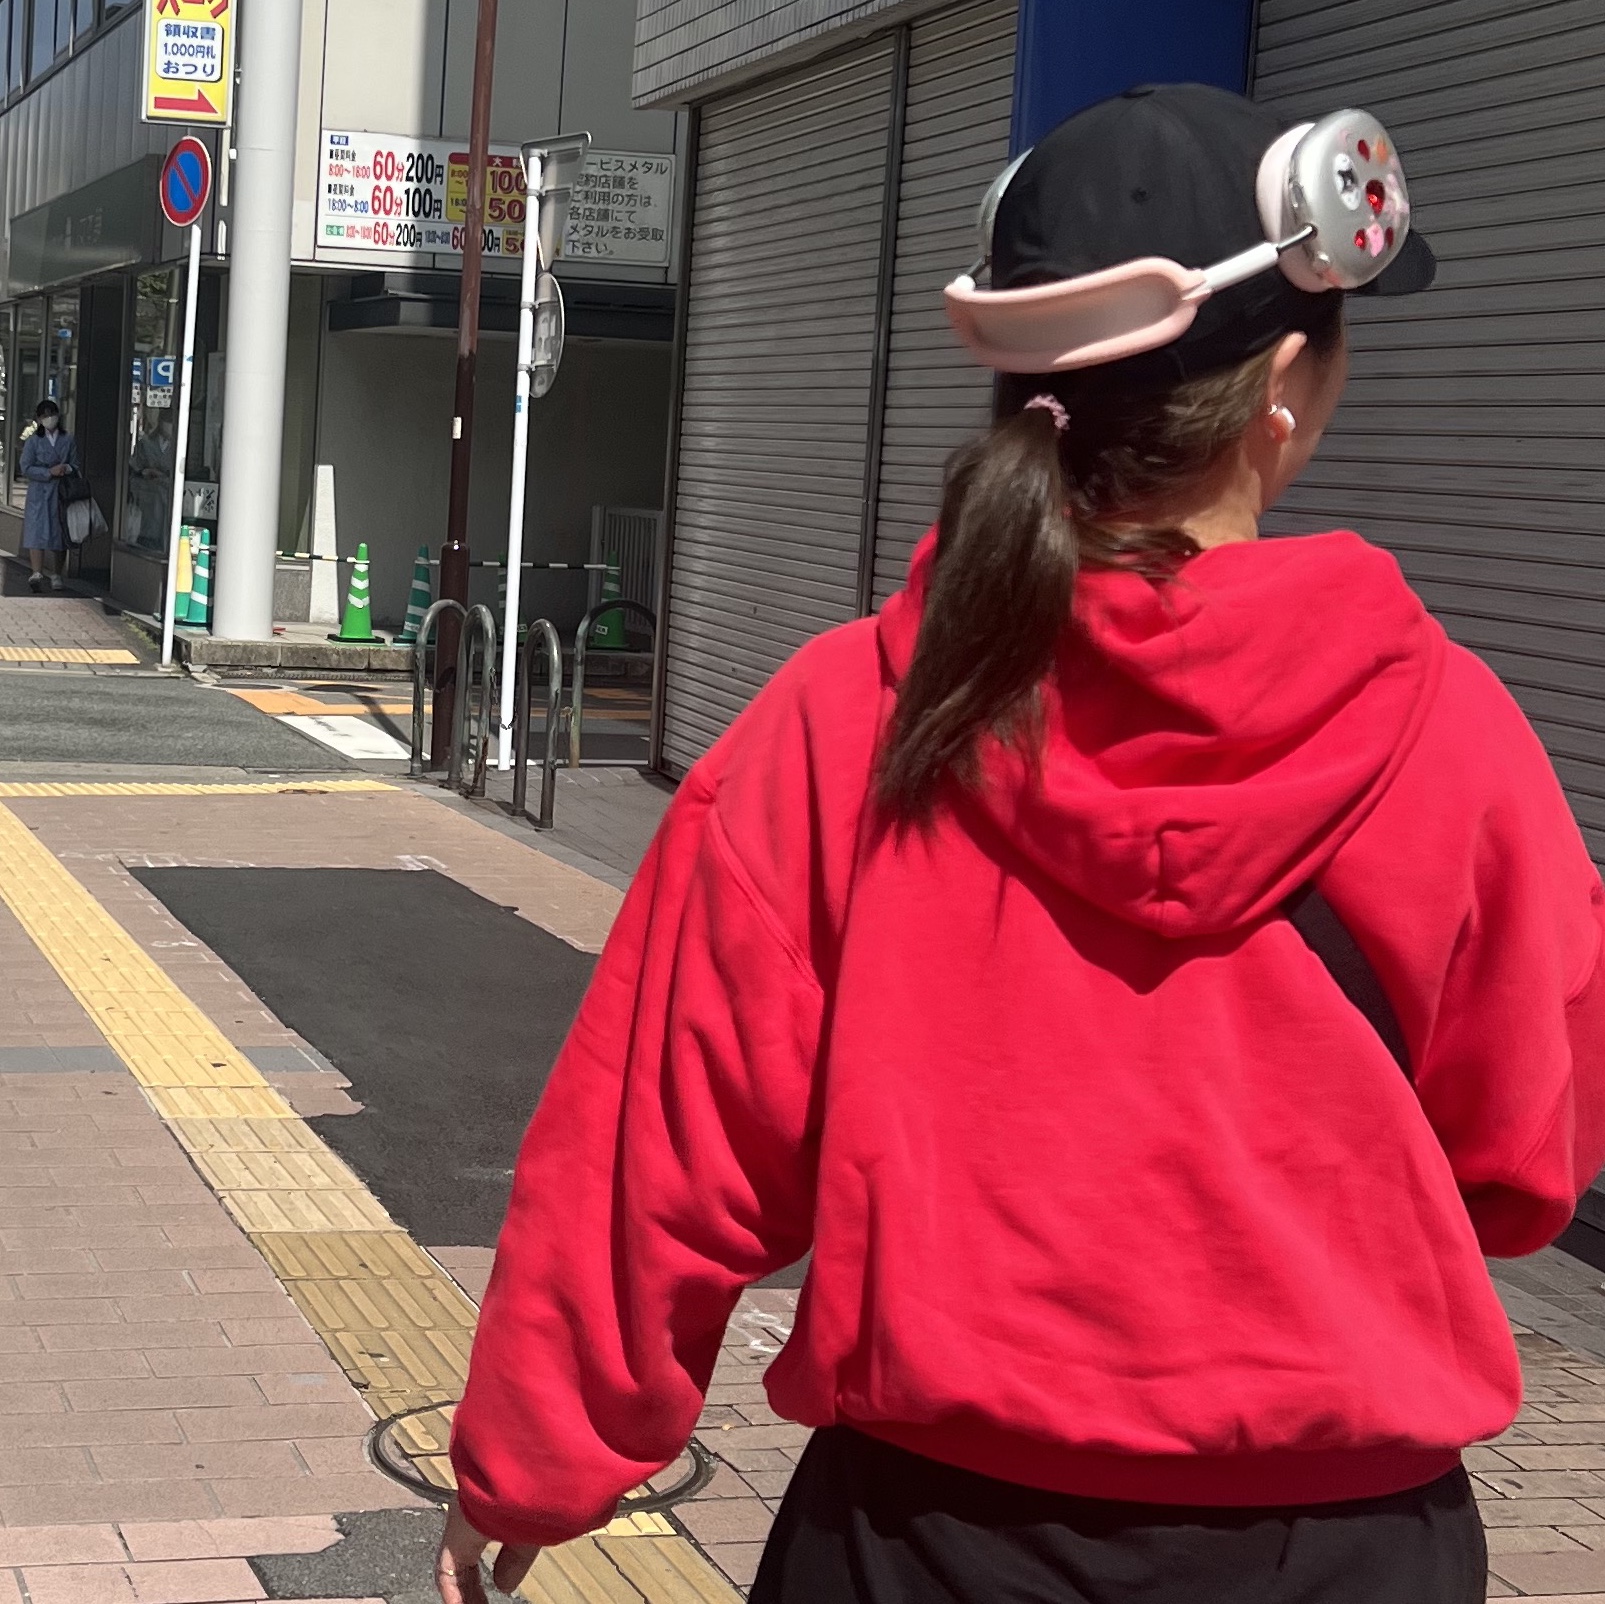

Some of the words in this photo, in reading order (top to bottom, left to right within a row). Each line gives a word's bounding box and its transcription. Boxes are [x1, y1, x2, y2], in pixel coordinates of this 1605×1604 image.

[164, 23, 216, 41] 領収書
[162, 60, 215, 77] おつり
[569, 205, 637, 223] 各店舗にて
[568, 223, 665, 242] メタルをお受取
